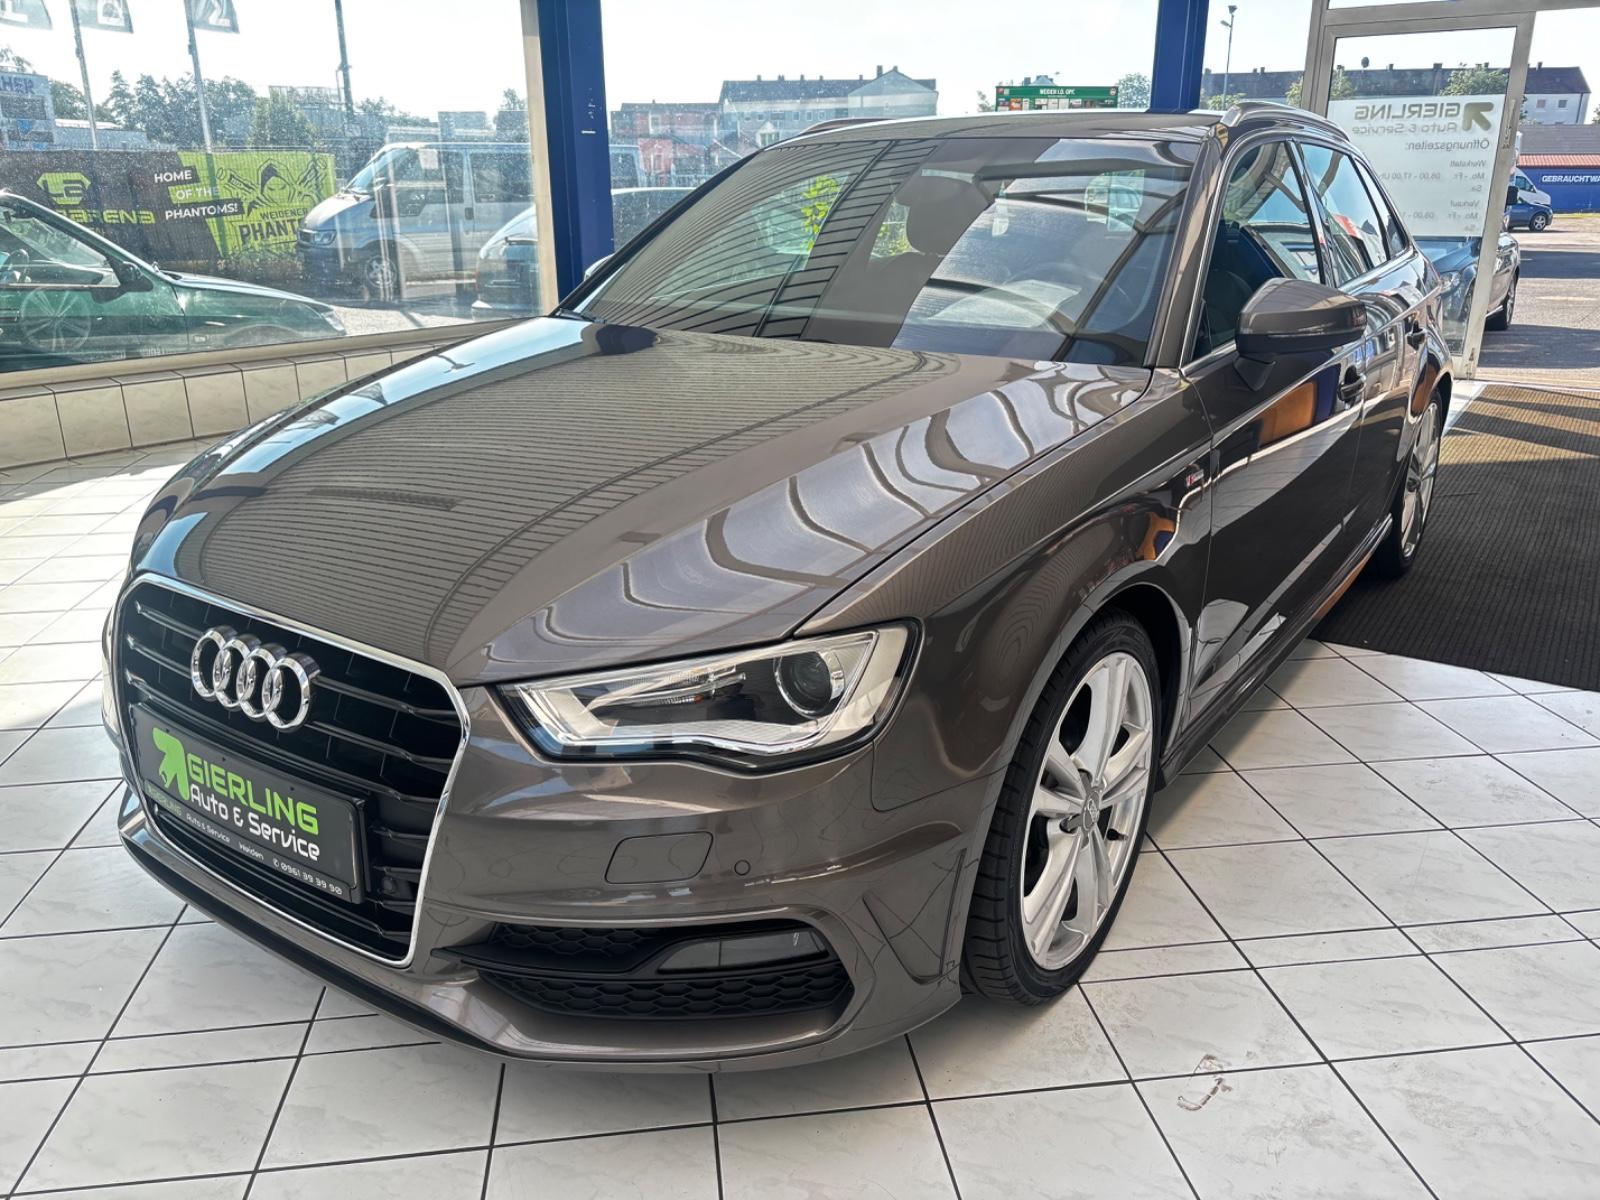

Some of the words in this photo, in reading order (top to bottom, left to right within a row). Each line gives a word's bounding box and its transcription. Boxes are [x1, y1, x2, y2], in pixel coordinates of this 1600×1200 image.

[154, 169, 192, 184] HOME
[175, 189, 193, 200] OF
[195, 186, 220, 199] THE
[164, 202, 239, 221] PHANTOMS!
[186, 752, 319, 835] GIERLING
[190, 783, 229, 820] Auto
[233, 806, 244, 827] &
[247, 811, 320, 861] Service
